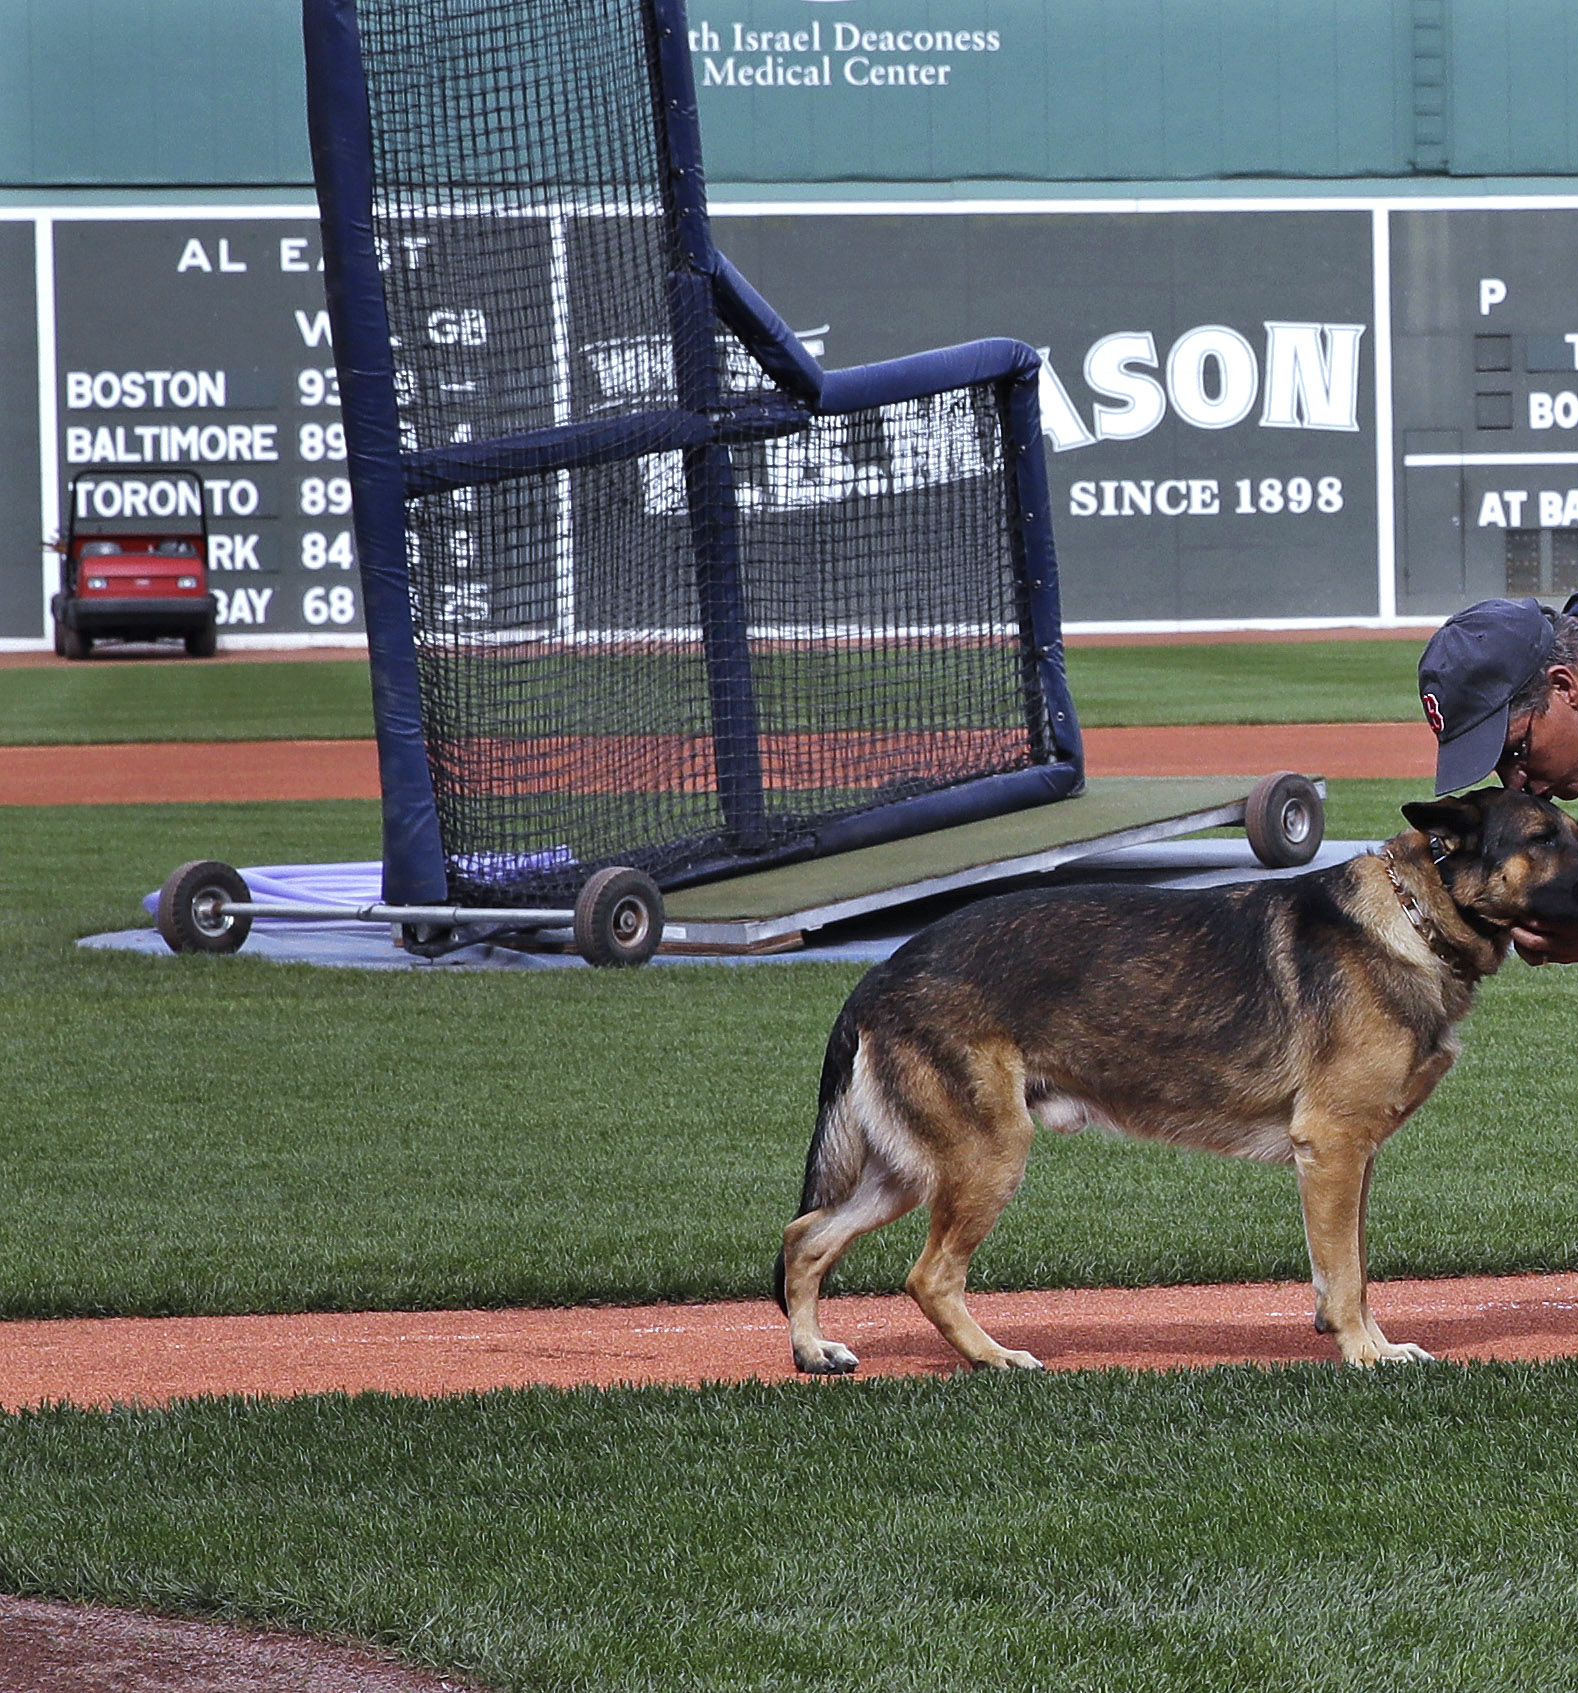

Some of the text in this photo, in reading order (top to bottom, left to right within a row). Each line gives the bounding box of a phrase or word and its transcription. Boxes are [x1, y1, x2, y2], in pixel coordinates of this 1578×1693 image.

[688, 20, 1001, 53] th Israel Deaconess
[702, 55, 952, 87] Medical Center
[177, 237, 430, 273] AL EST
[1480, 278, 1507, 316] P
[67, 370, 226, 409] BOSTON
[66, 424, 279, 463] BALTIMORE
[299, 422, 346, 462] 89
[67, 479, 259, 518] TORONTO
[300, 477, 353, 516] 89
[1070, 476, 1344, 516] SINCE 1898
[1478, 490, 1528, 528] AT
[208, 534, 260, 570] RK
[301, 531, 354, 570] 84
[303, 585, 355, 625] 68
